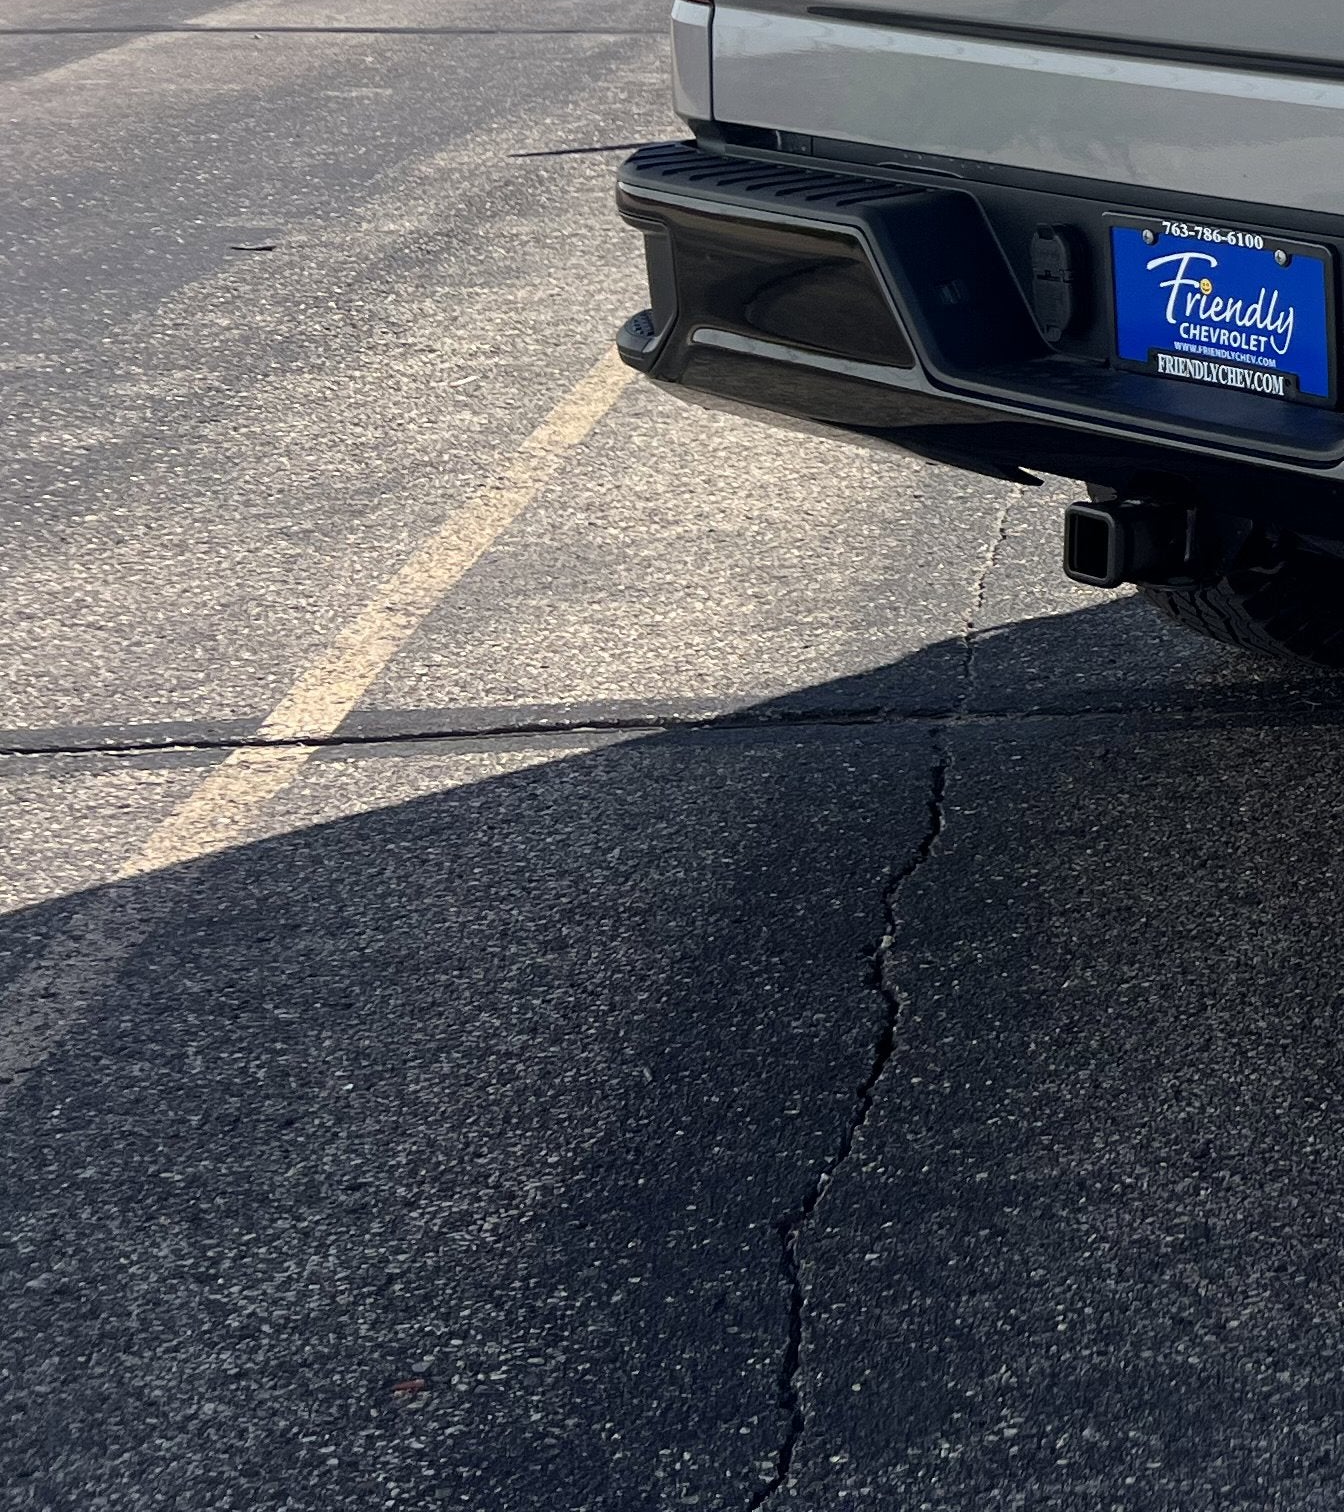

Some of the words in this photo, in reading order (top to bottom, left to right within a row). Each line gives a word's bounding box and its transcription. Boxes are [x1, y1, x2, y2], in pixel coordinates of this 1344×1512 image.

[1161, 220, 1264, 250] 763-786-6100
[1146, 251, 1295, 355] Friendly
[1179, 322, 1268, 353] CHEVROLET
[1173, 341, 1277, 368] WWW.FRIENDLYCHEV.COM
[1156, 353, 1285, 396] FRIENDLYCHEV.COM
